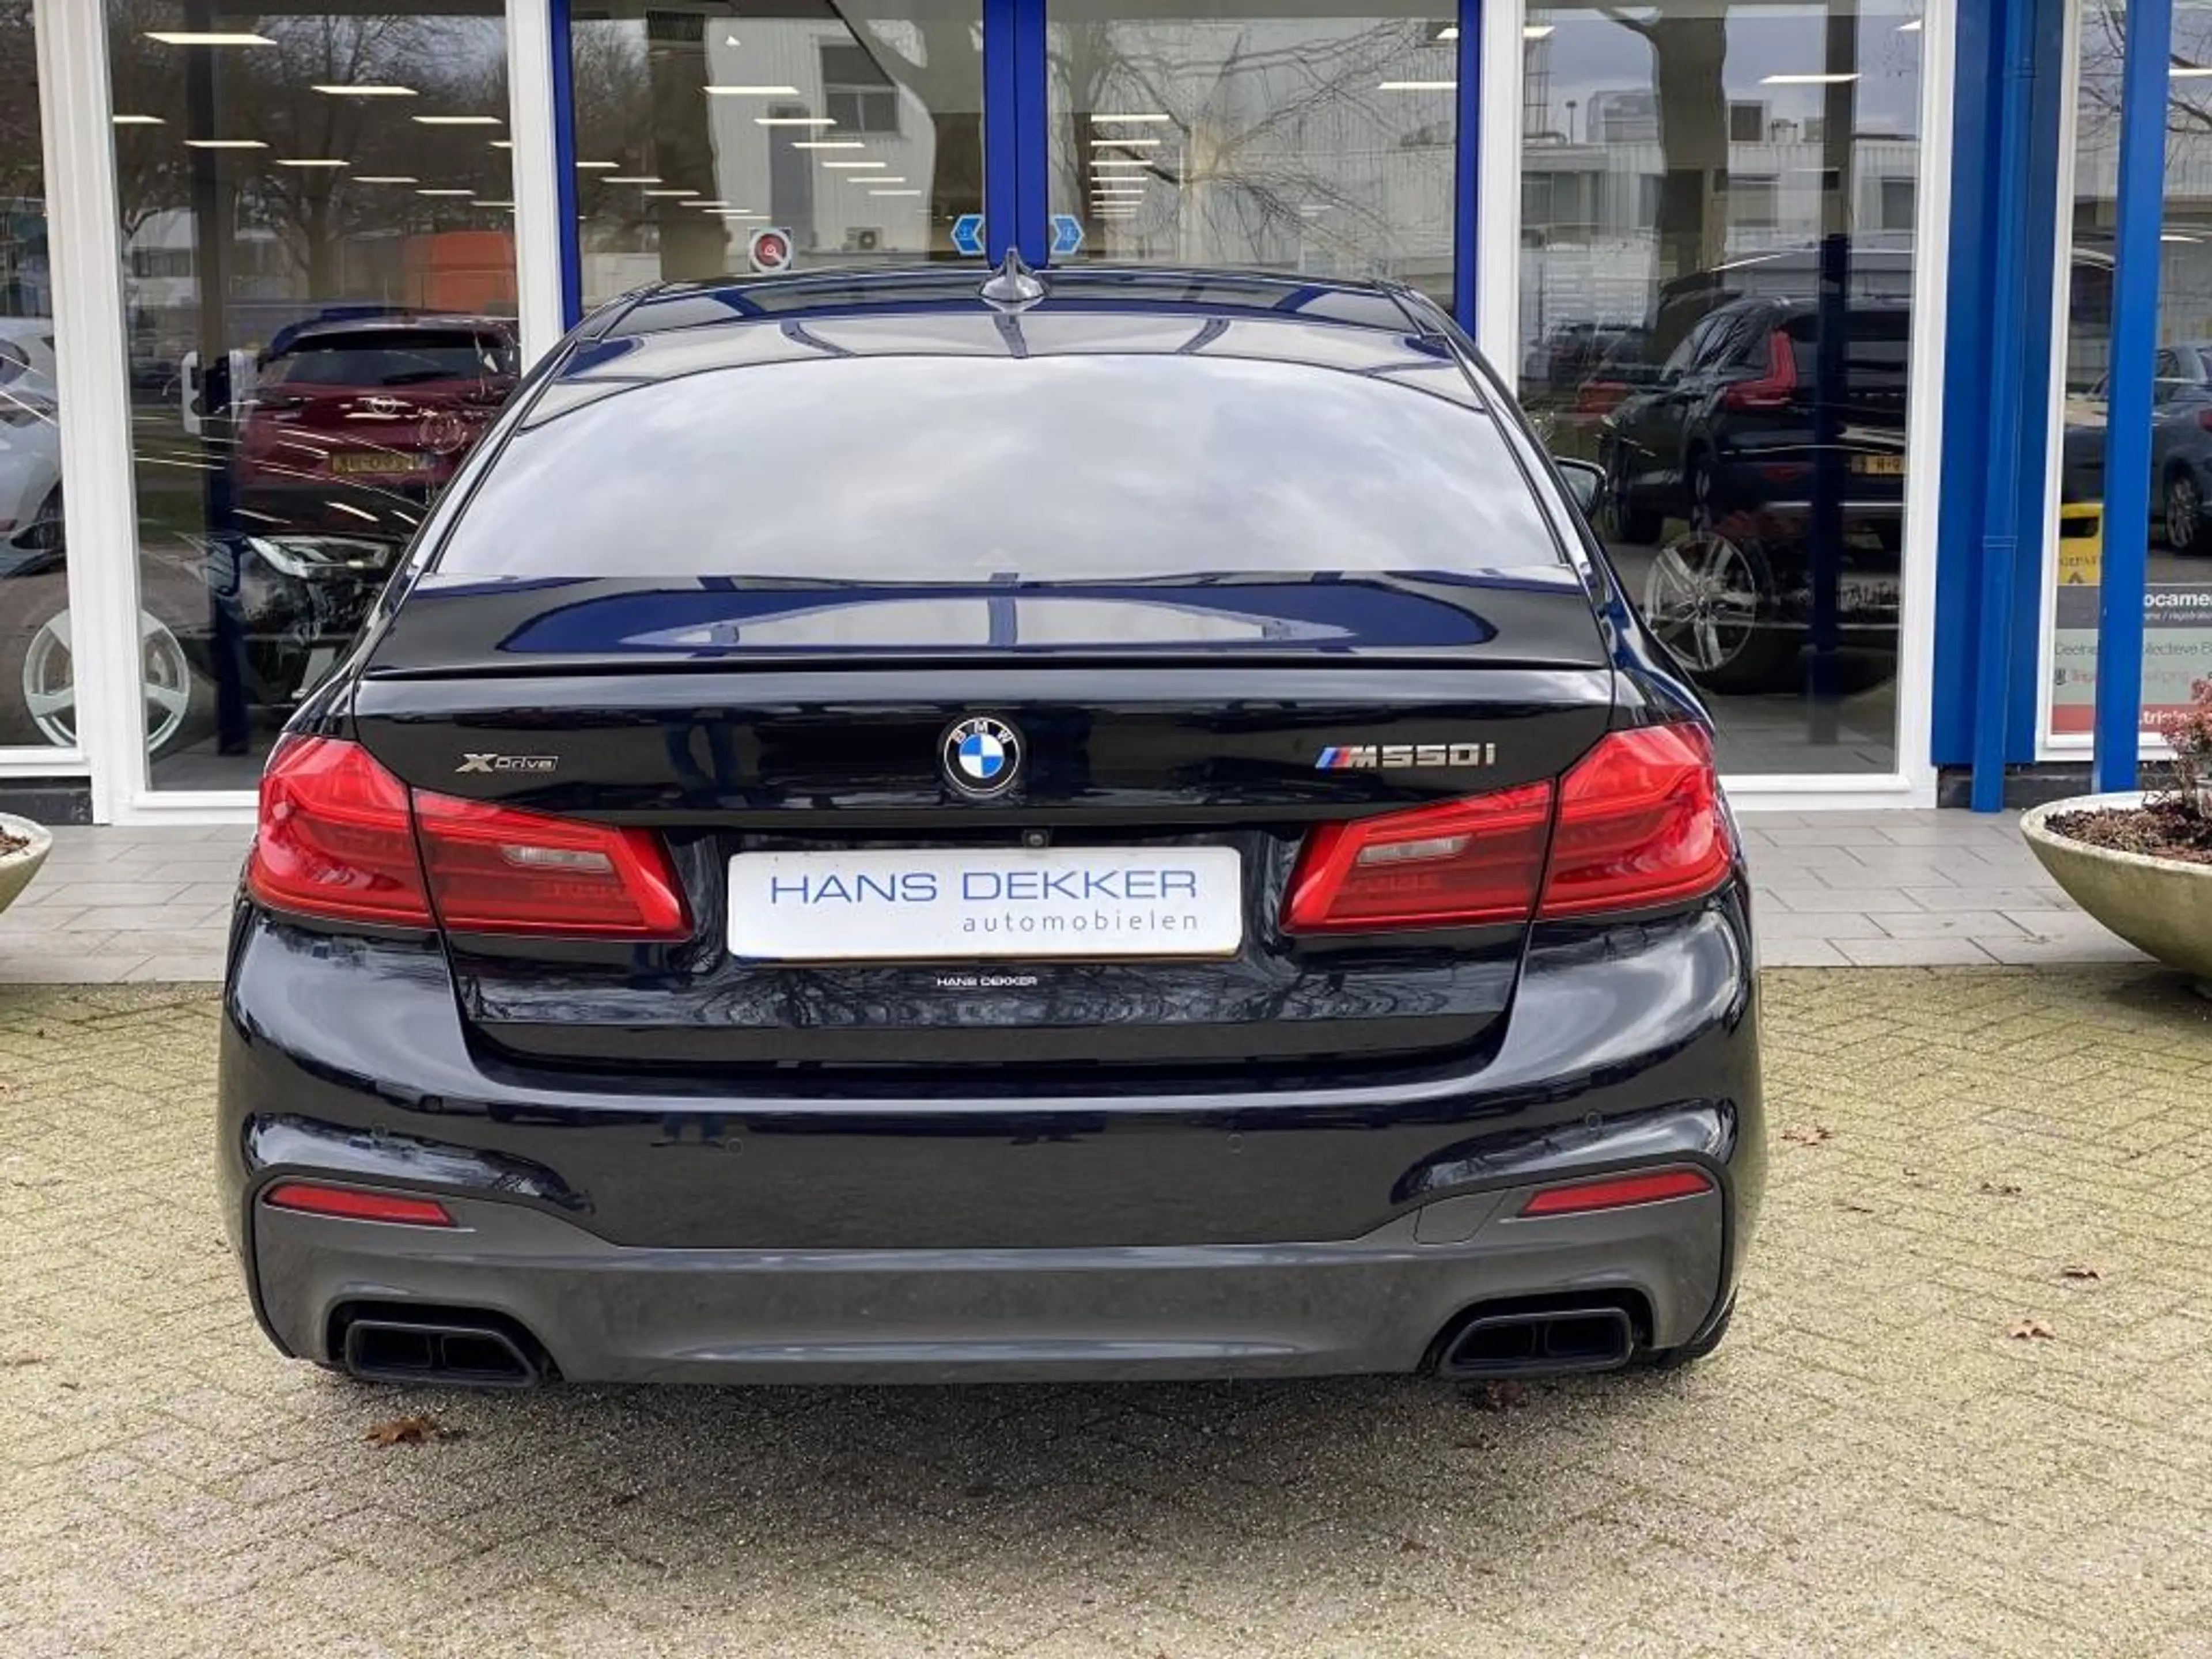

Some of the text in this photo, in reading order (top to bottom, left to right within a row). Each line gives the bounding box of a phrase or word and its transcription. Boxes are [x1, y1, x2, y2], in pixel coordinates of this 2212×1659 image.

[951, 719, 1014, 744] BMW
[771, 870, 1196, 904] HANS DEKKER
[963, 909, 1198, 933] automobielen
[937, 977, 978, 986] HANS
